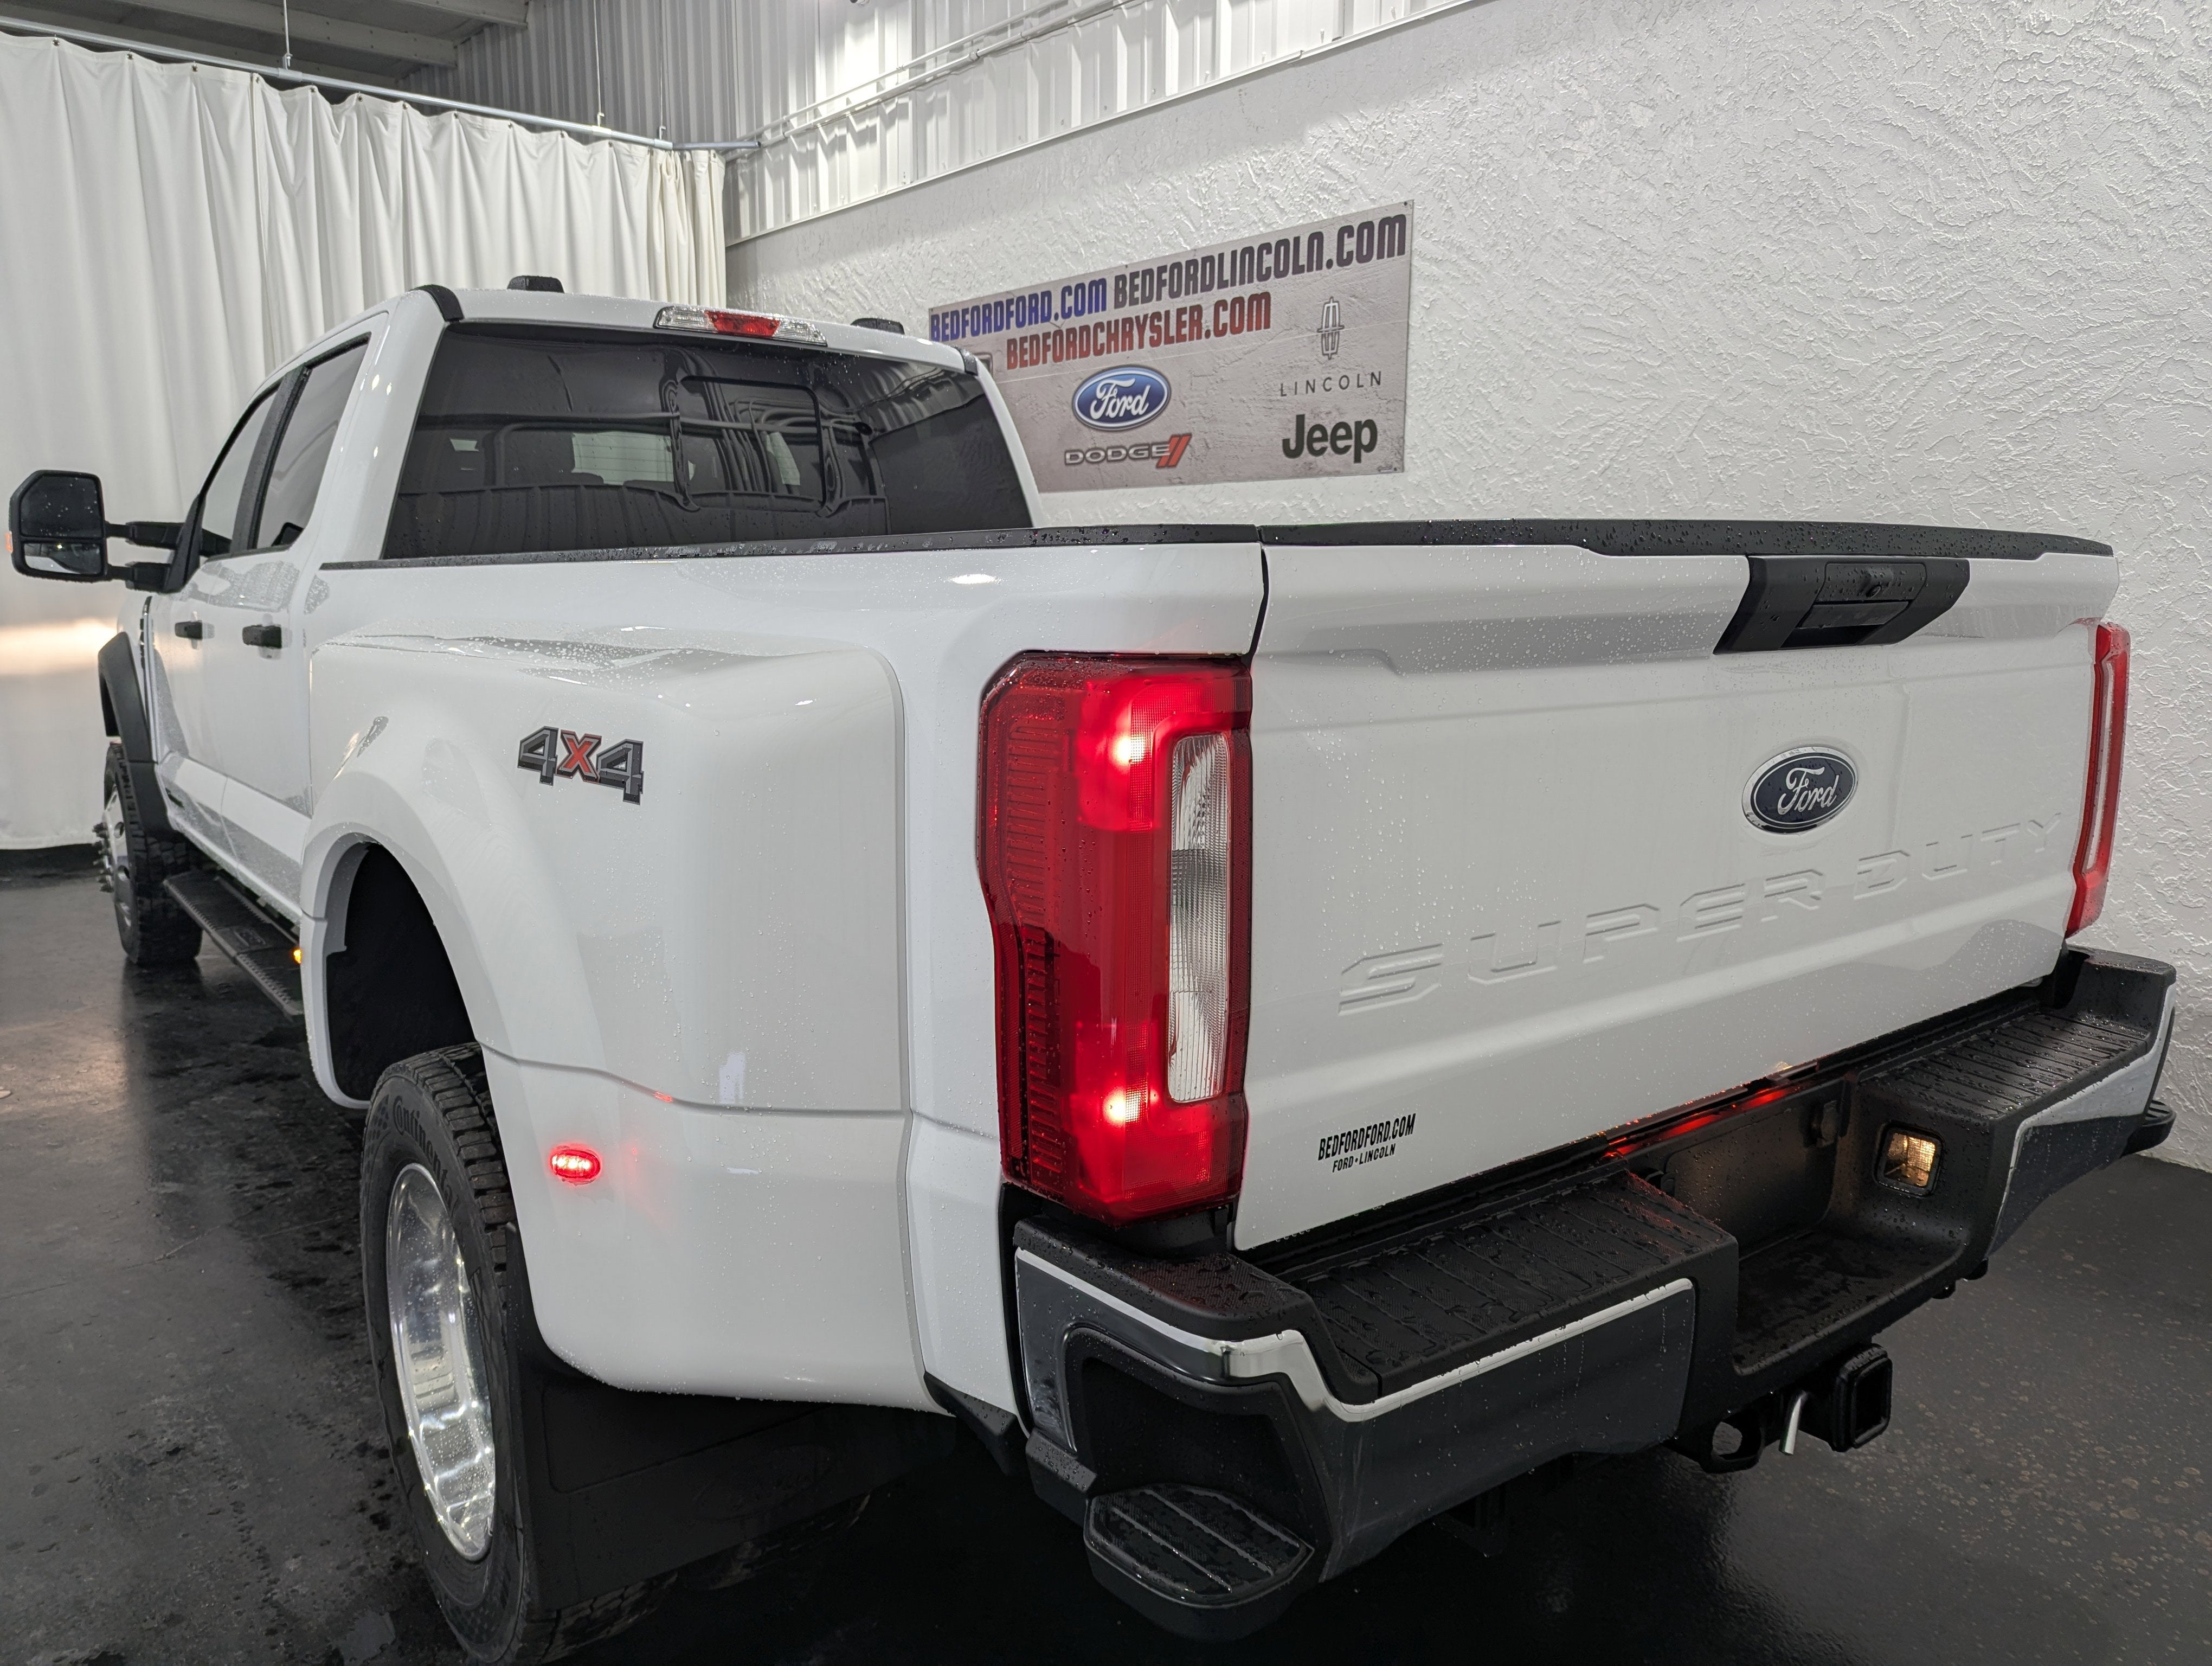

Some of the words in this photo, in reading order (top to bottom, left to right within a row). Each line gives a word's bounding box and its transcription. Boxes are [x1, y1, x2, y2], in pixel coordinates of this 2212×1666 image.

[931, 277, 1107, 342] BEDFORDFORD.COM
[1114, 214, 1406, 310] BEDFORDLINCOLN.COM
[1007, 291, 1271, 371] BEDFORDCHRYSLER.COM
[1090, 377, 1151, 420] Ford
[1280, 370, 1382, 397] LINCOLN
[1065, 441, 1171, 465] DODGE
[1282, 414, 1378, 464] Jeep
[1777, 766, 1840, 815] Ford
[1338, 869, 1823, 1016] SUPER
[1853, 812, 2062, 900] DUTY
[1318, 1113, 1416, 1161] BEDFORDFORD.COM
